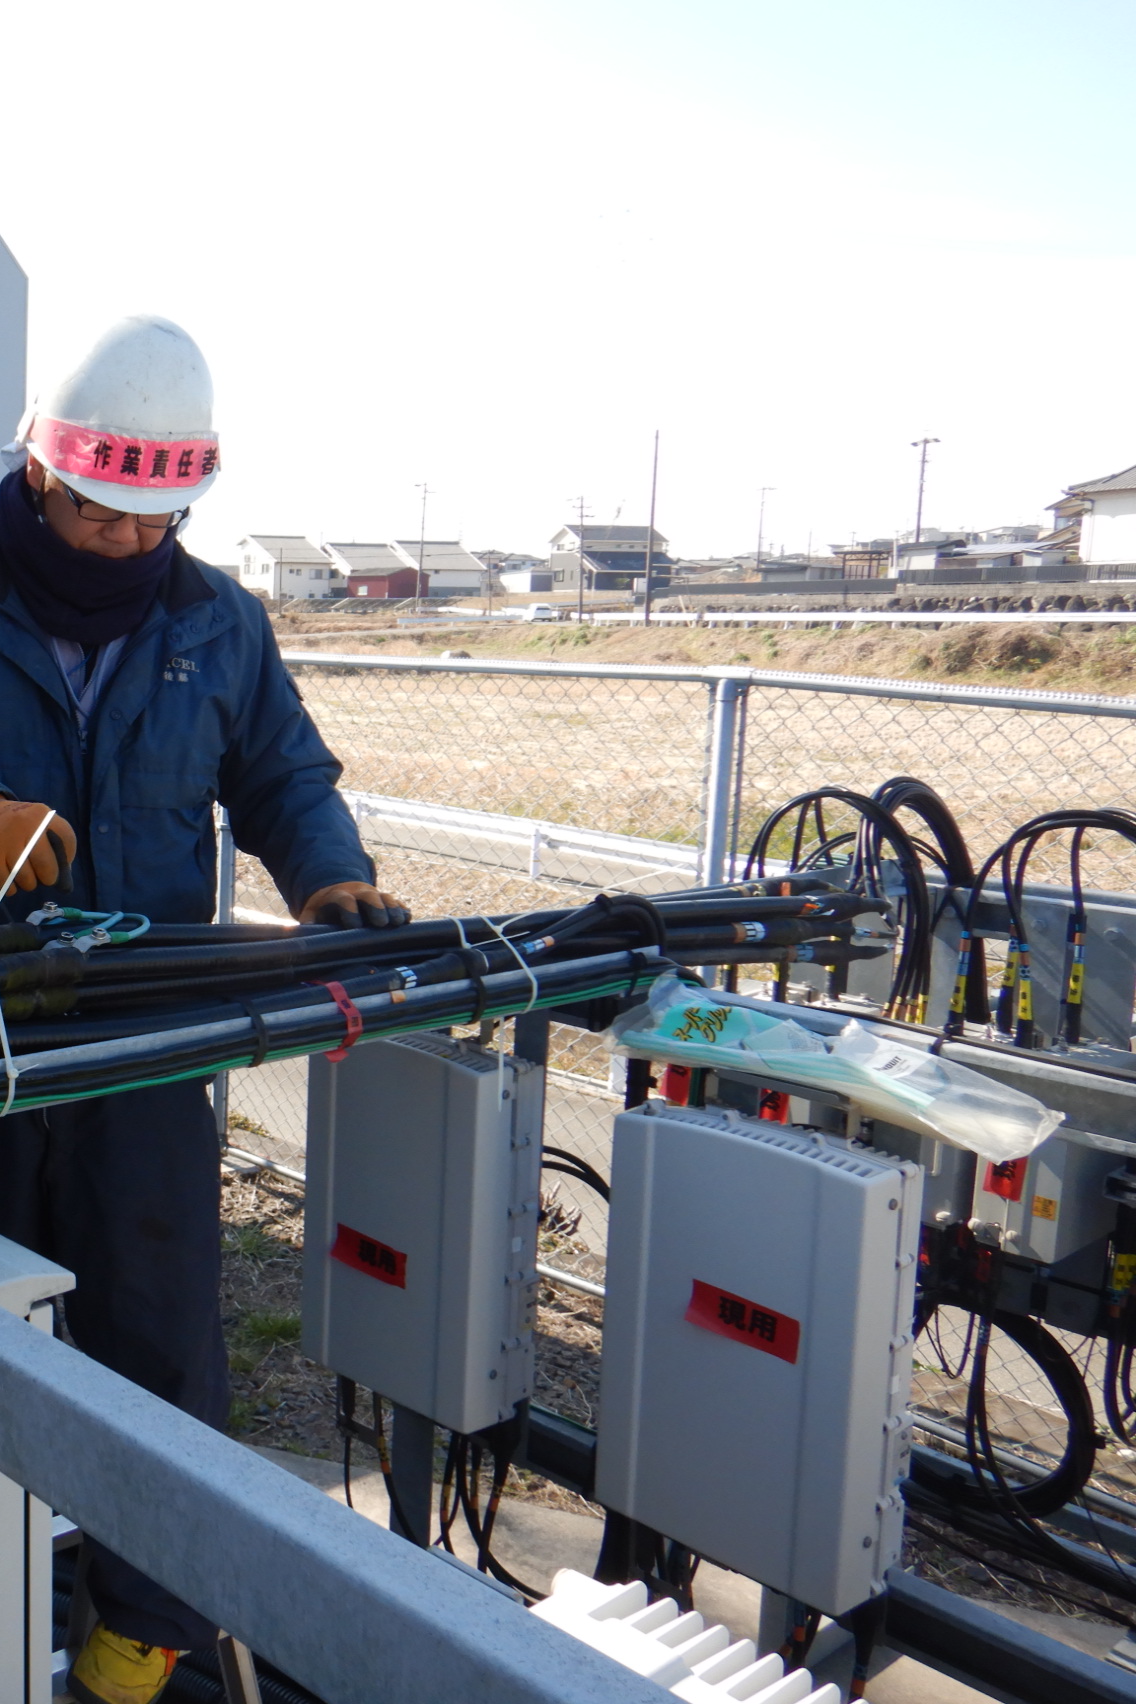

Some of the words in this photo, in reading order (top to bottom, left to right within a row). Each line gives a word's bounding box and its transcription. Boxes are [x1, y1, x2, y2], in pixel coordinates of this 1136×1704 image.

[93, 440, 218, 479] 作業責任者
[167, 657, 200, 672] CEL
[717, 1295, 778, 1344] 現用
